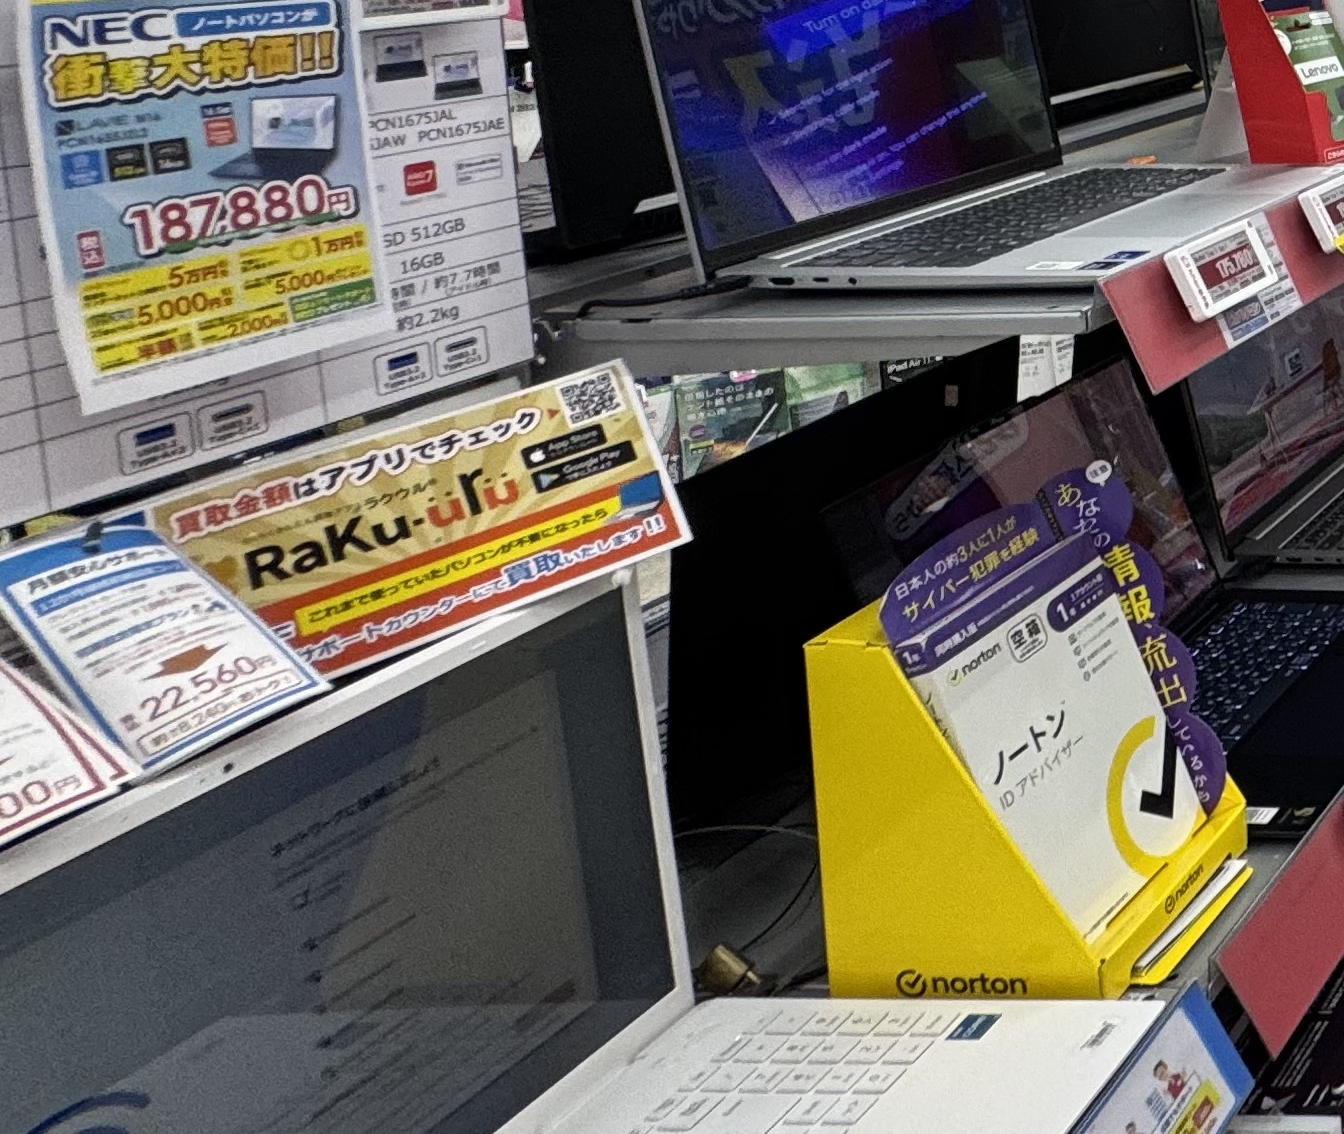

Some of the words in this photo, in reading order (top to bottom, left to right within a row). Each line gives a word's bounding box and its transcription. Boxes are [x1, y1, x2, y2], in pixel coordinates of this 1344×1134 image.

[49, 13, 170, 50] NEC
[1300, 62, 1341, 79] Lenovo
[413, 219, 466, 242] 512GB
[401, 253, 445, 275] 16GB
[962, 642, 1002, 678] norton
[992, 707, 1067, 787] ノートン
[999, 788, 1015, 811] ID
[1175, 863, 1205, 903] norton
[932, 972, 1028, 997] norton
